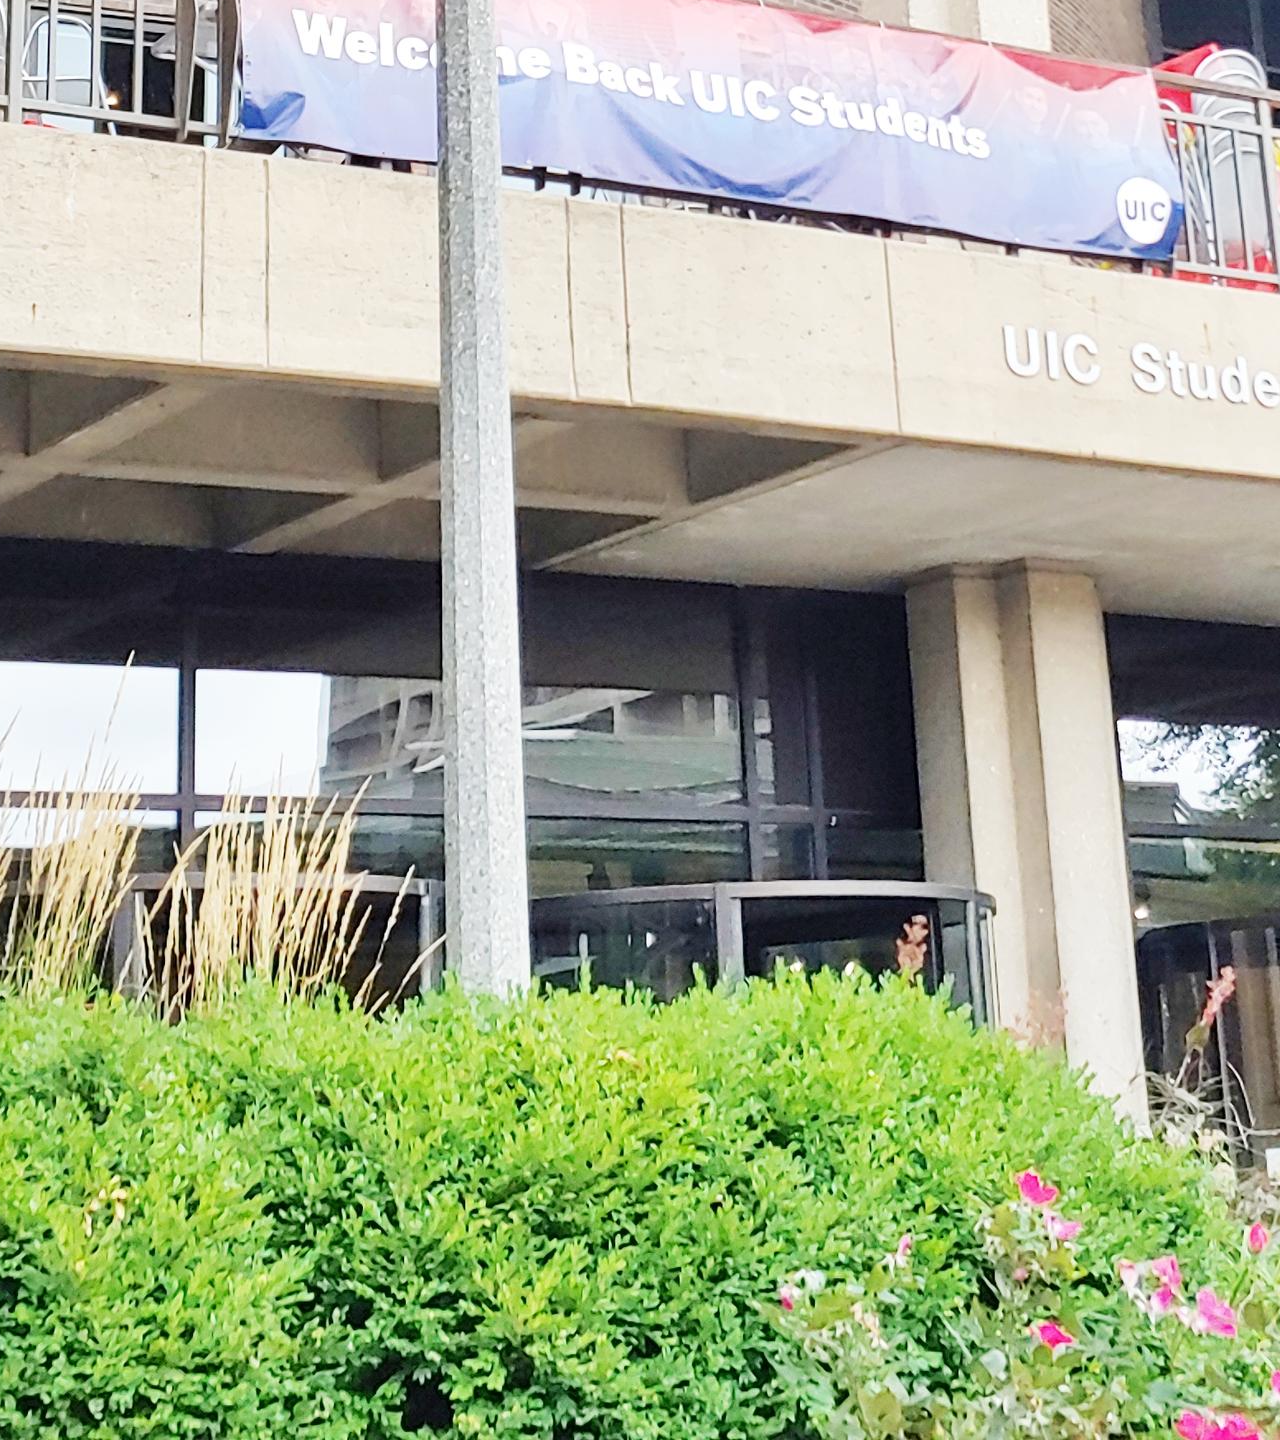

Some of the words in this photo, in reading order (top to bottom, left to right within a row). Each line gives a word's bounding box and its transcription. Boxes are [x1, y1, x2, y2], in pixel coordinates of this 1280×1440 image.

[291, 8, 552, 80] Welce
[561, 40, 687, 106] Back
[688, 70, 782, 122] UIC
[790, 86, 991, 159] Students
[1124, 199, 1166, 222] UIC
[1002, 325, 1102, 385] UIC
